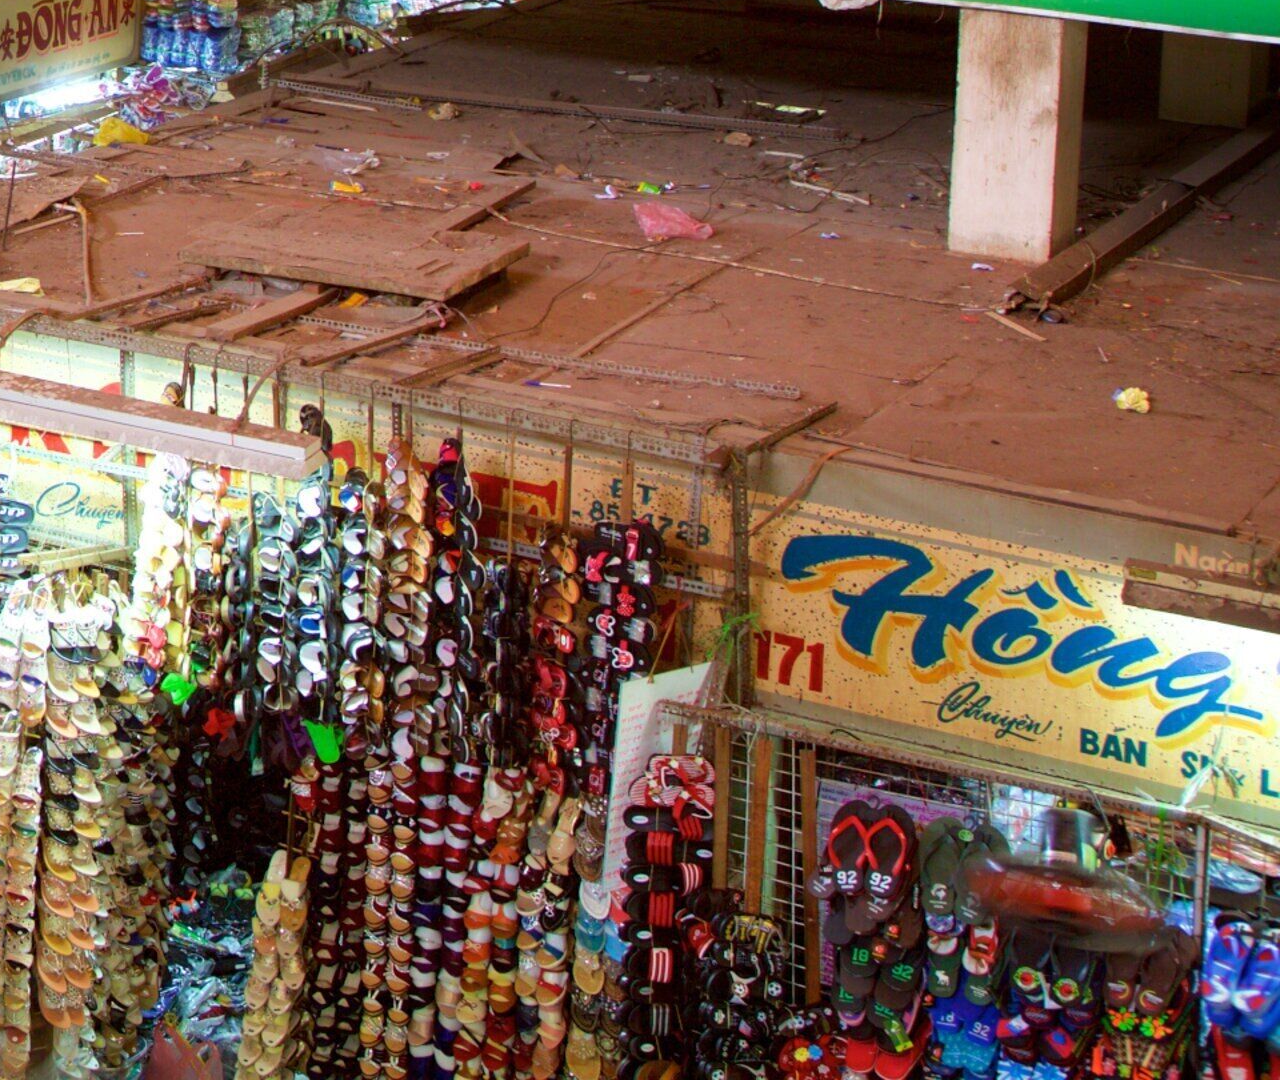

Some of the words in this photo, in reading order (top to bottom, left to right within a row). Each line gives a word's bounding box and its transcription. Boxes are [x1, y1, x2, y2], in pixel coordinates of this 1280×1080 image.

[1079, 725, 1147, 768] BÁN
[836, 870, 858, 885] 92
[869, 871, 893, 889] 92
